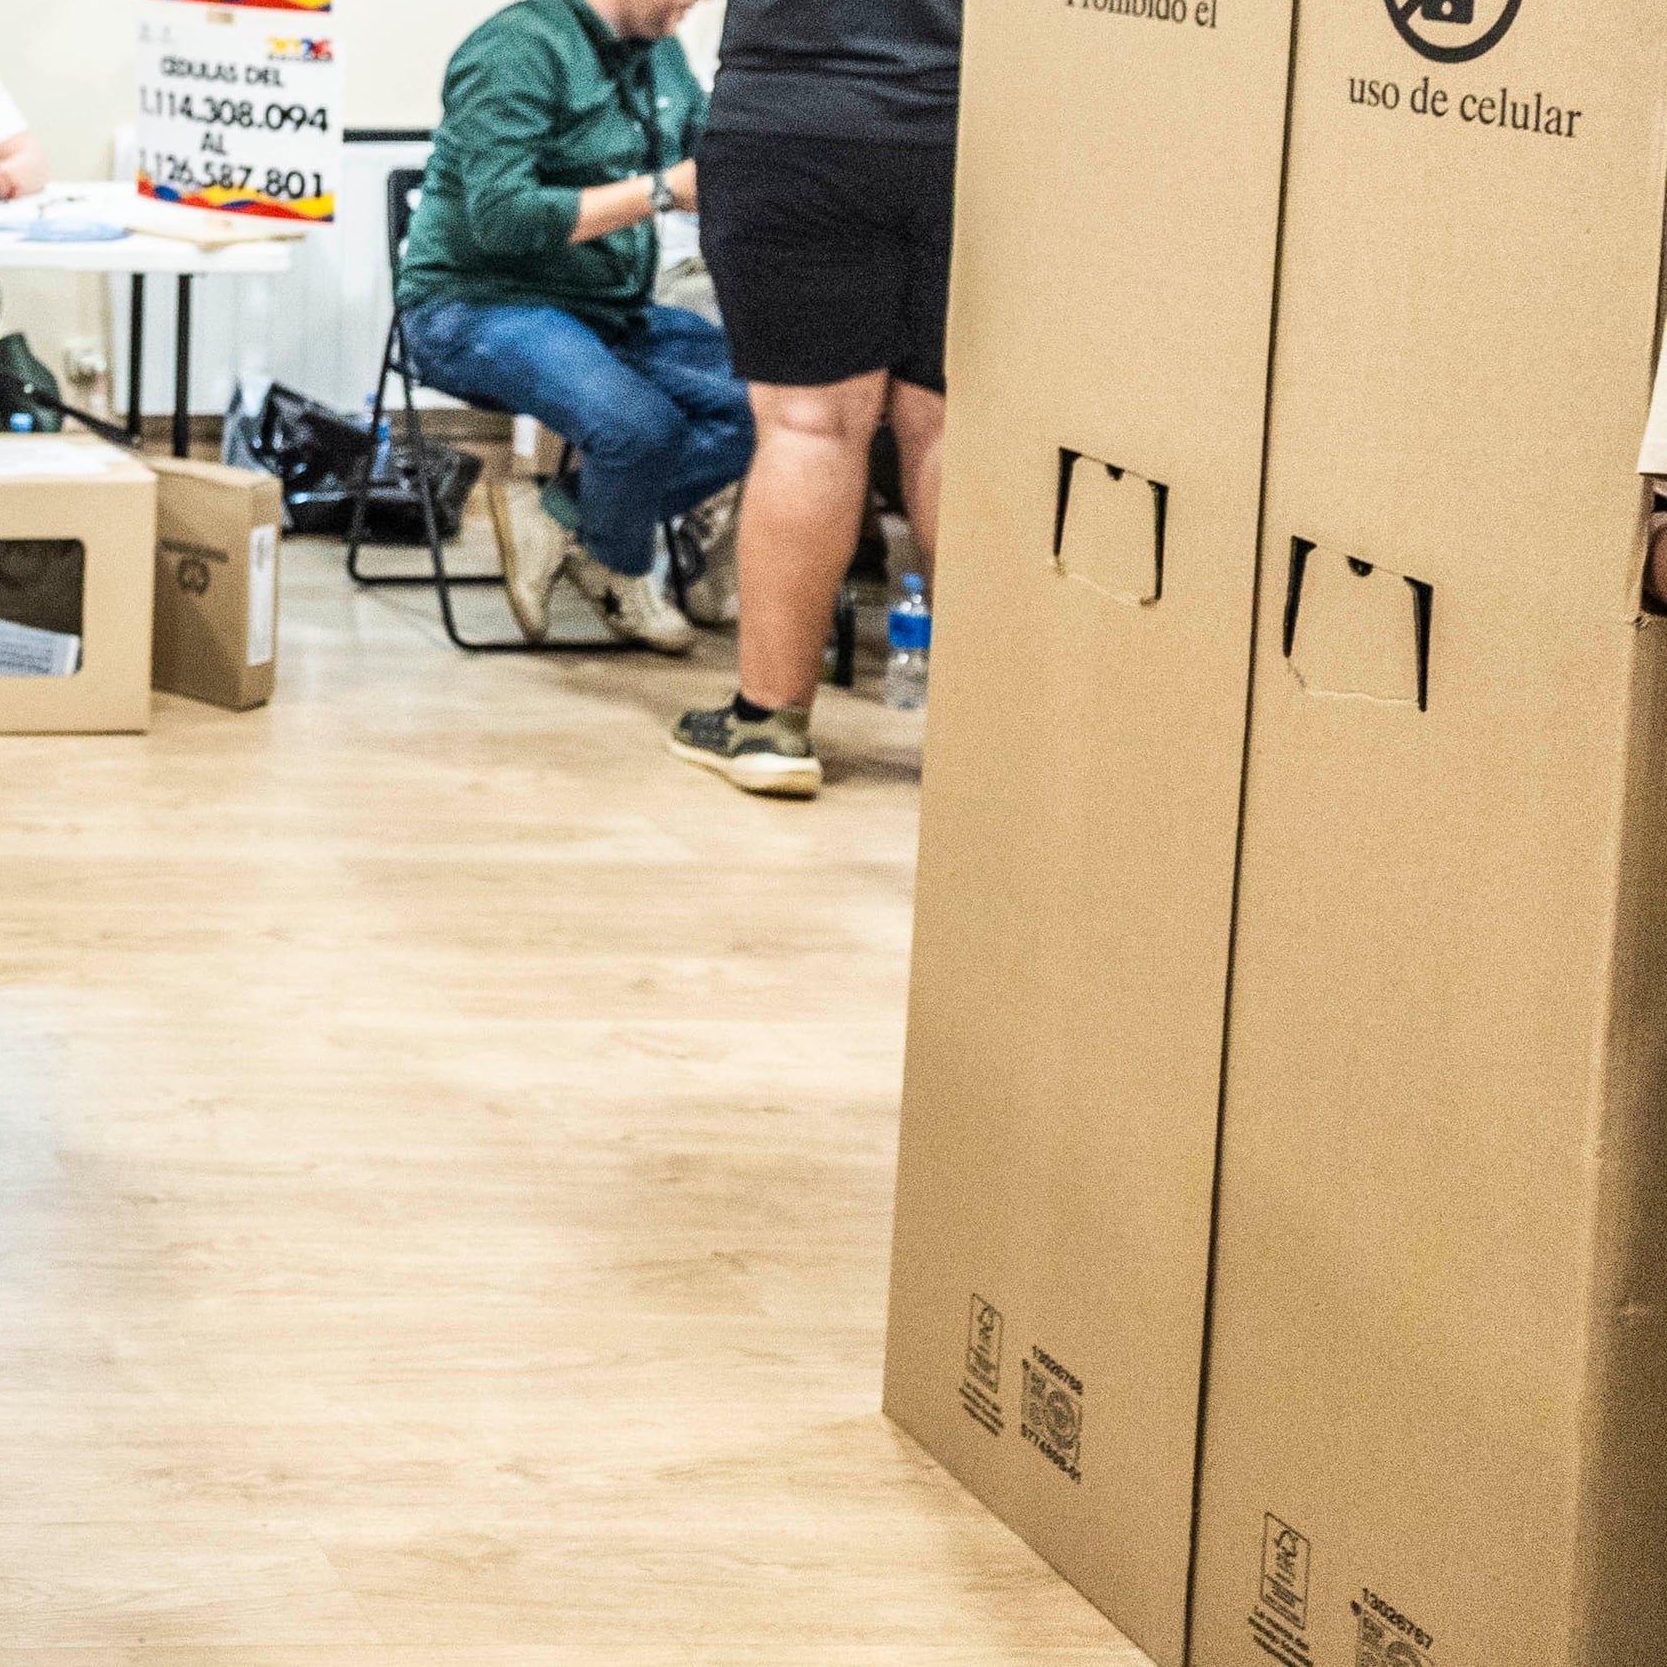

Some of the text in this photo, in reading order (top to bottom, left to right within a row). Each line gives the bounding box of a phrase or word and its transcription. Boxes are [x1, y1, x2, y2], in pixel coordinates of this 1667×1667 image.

[245, 64, 284, 87] DEL
[1349, 76, 1582, 137] uso de celular
[201, 132, 227, 155] AL
